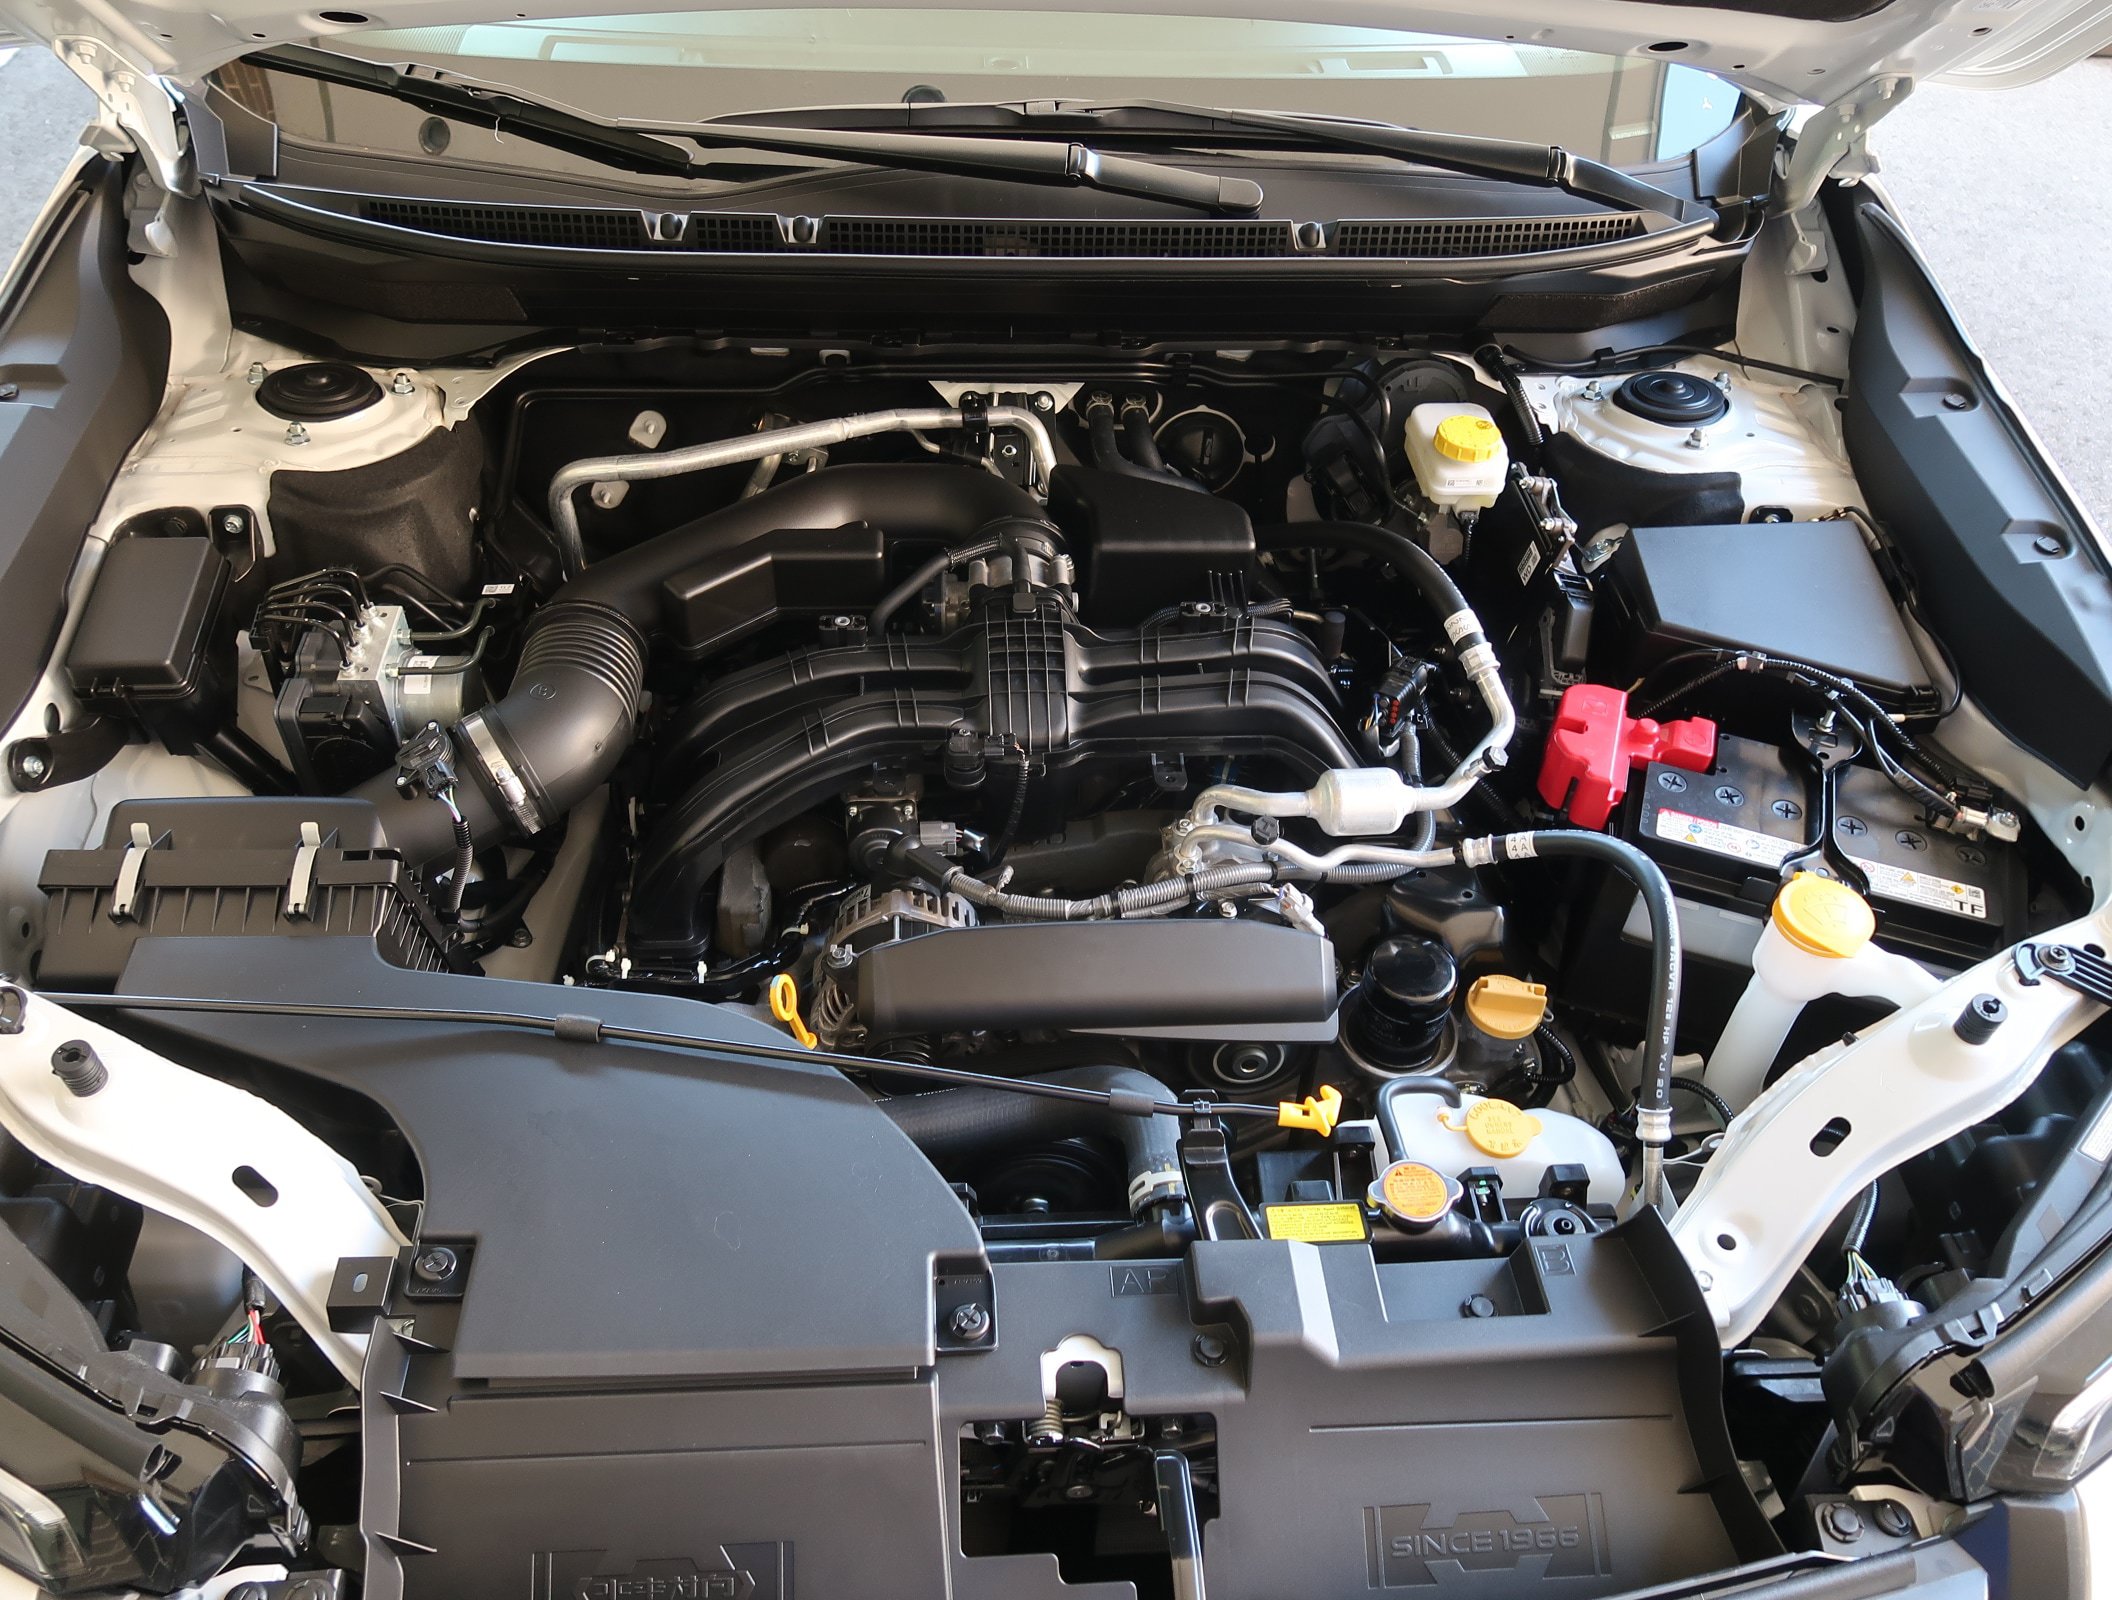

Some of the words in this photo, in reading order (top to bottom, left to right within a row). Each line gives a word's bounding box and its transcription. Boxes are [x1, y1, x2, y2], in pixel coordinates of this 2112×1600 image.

[1953, 899, 1985, 916] TF
[1663, 1026, 1670, 1045] HP
[1390, 1530, 1493, 1558] SINCE
[1499, 1526, 1580, 1552] 1966
